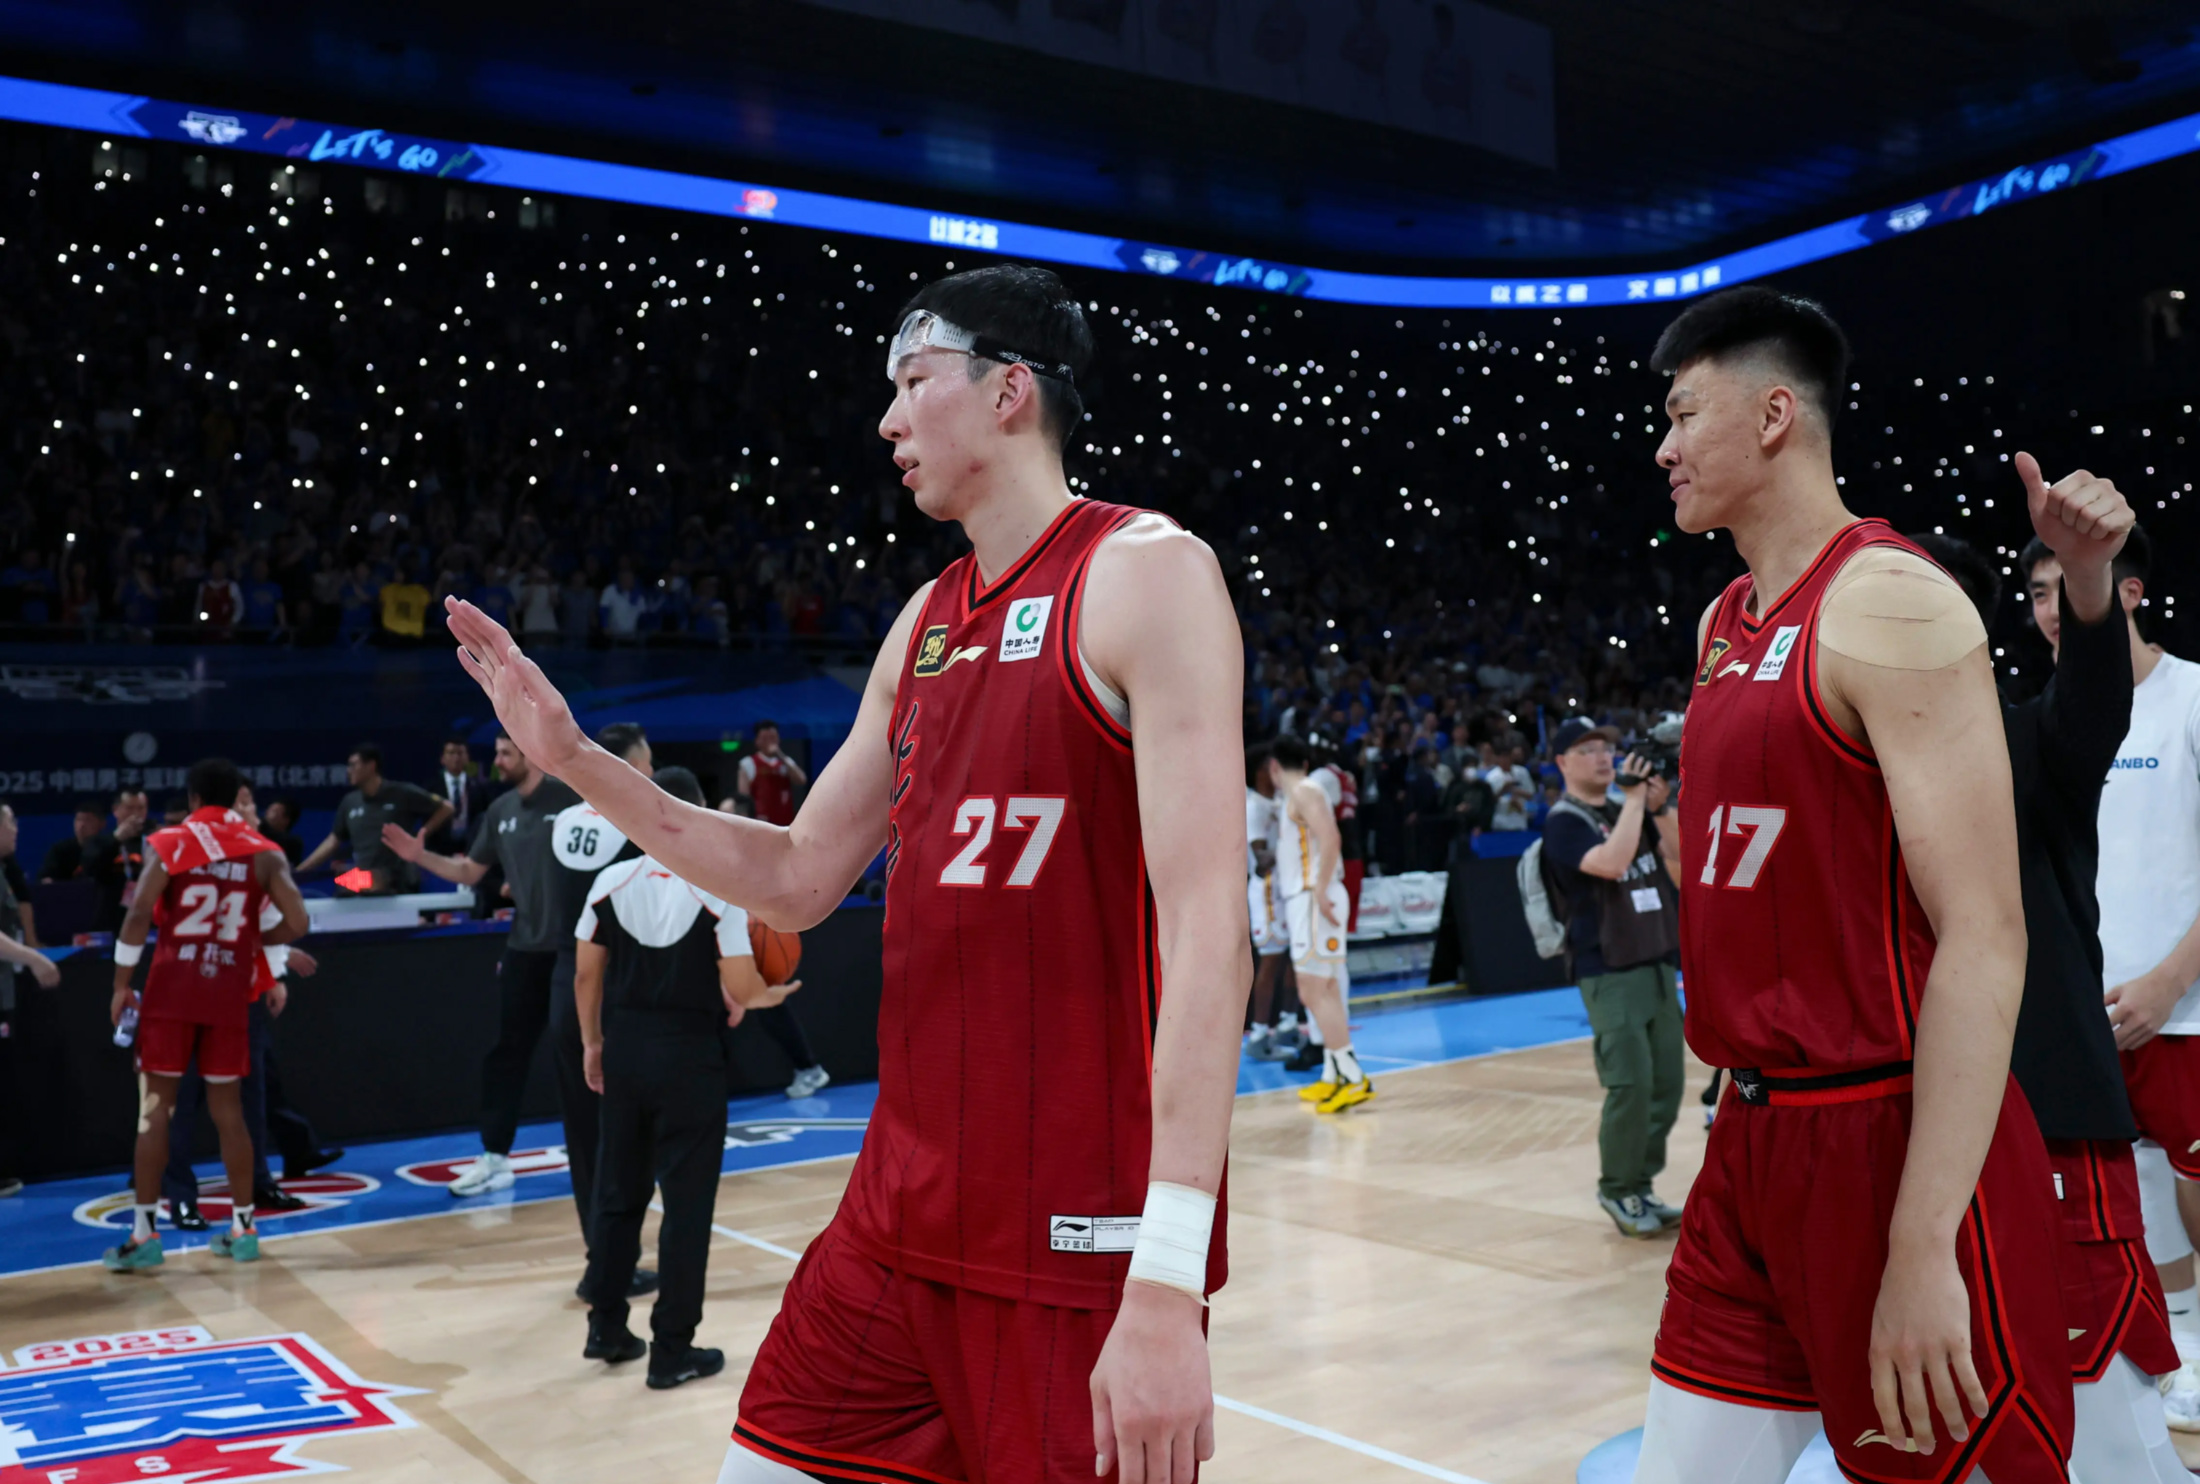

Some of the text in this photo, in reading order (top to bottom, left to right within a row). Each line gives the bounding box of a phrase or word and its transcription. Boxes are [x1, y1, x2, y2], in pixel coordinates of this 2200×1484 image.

[308, 129, 439, 171] LET'S GO
[1003, 646, 1038, 656] CHINA LIFE
[1005, 635, 1040, 649] 中国人寿
[567, 826, 600, 857] 36
[936, 794, 1068, 889] 27
[1699, 802, 1789, 891] 17
[173, 884, 248, 942] 24
[30, 1330, 197, 1361] 2025
